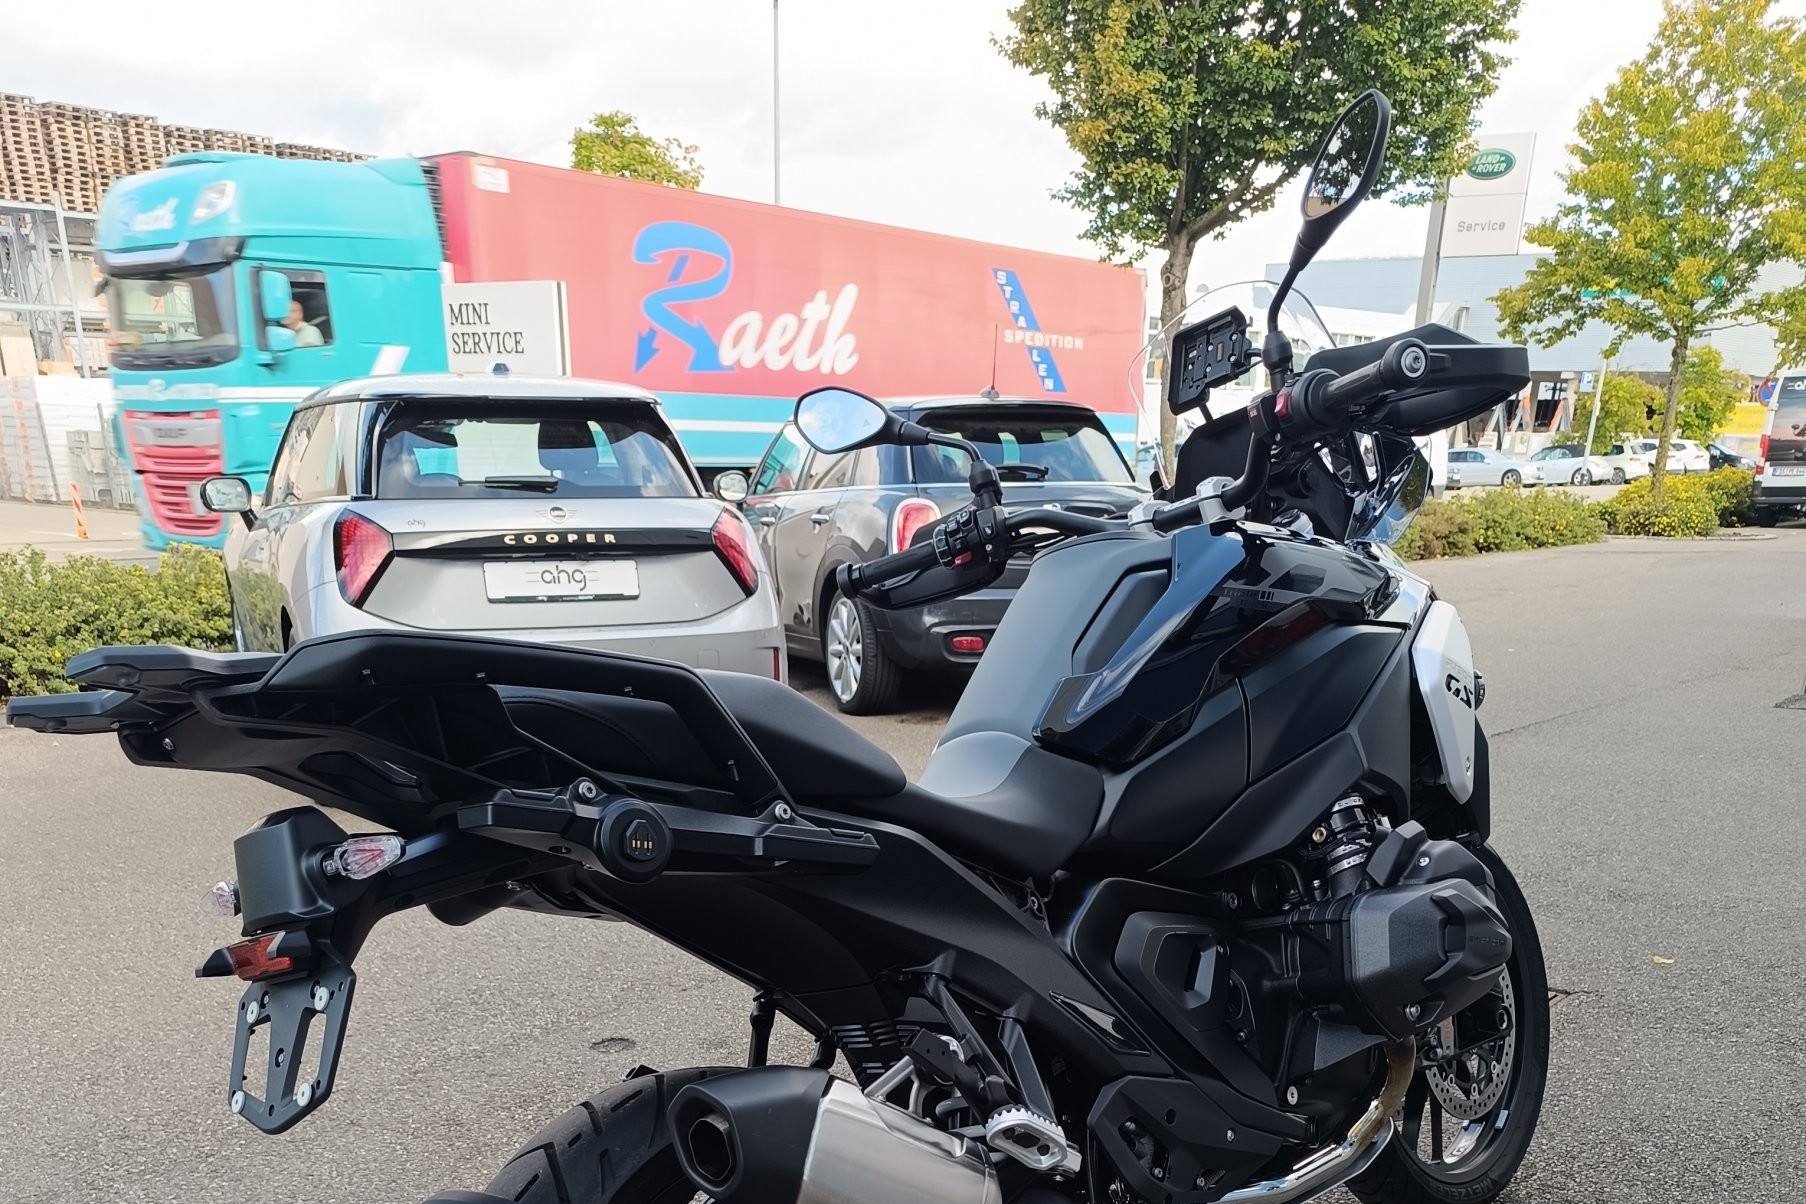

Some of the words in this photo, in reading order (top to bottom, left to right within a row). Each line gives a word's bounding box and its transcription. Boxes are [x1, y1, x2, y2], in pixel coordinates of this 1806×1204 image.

[1475, 154, 1500, 165] LAND
[1476, 163, 1507, 173] ROVER
[1457, 220, 1506, 233] Service
[632, 220, 859, 376] Raeth
[448, 303, 490, 325] MINI
[451, 331, 524, 354] SERVICE
[1004, 329, 1084, 350] SPEDITION
[503, 533, 616, 545] COOPER
[540, 565, 587, 592] ahg
[1445, 673, 1474, 710] GS
